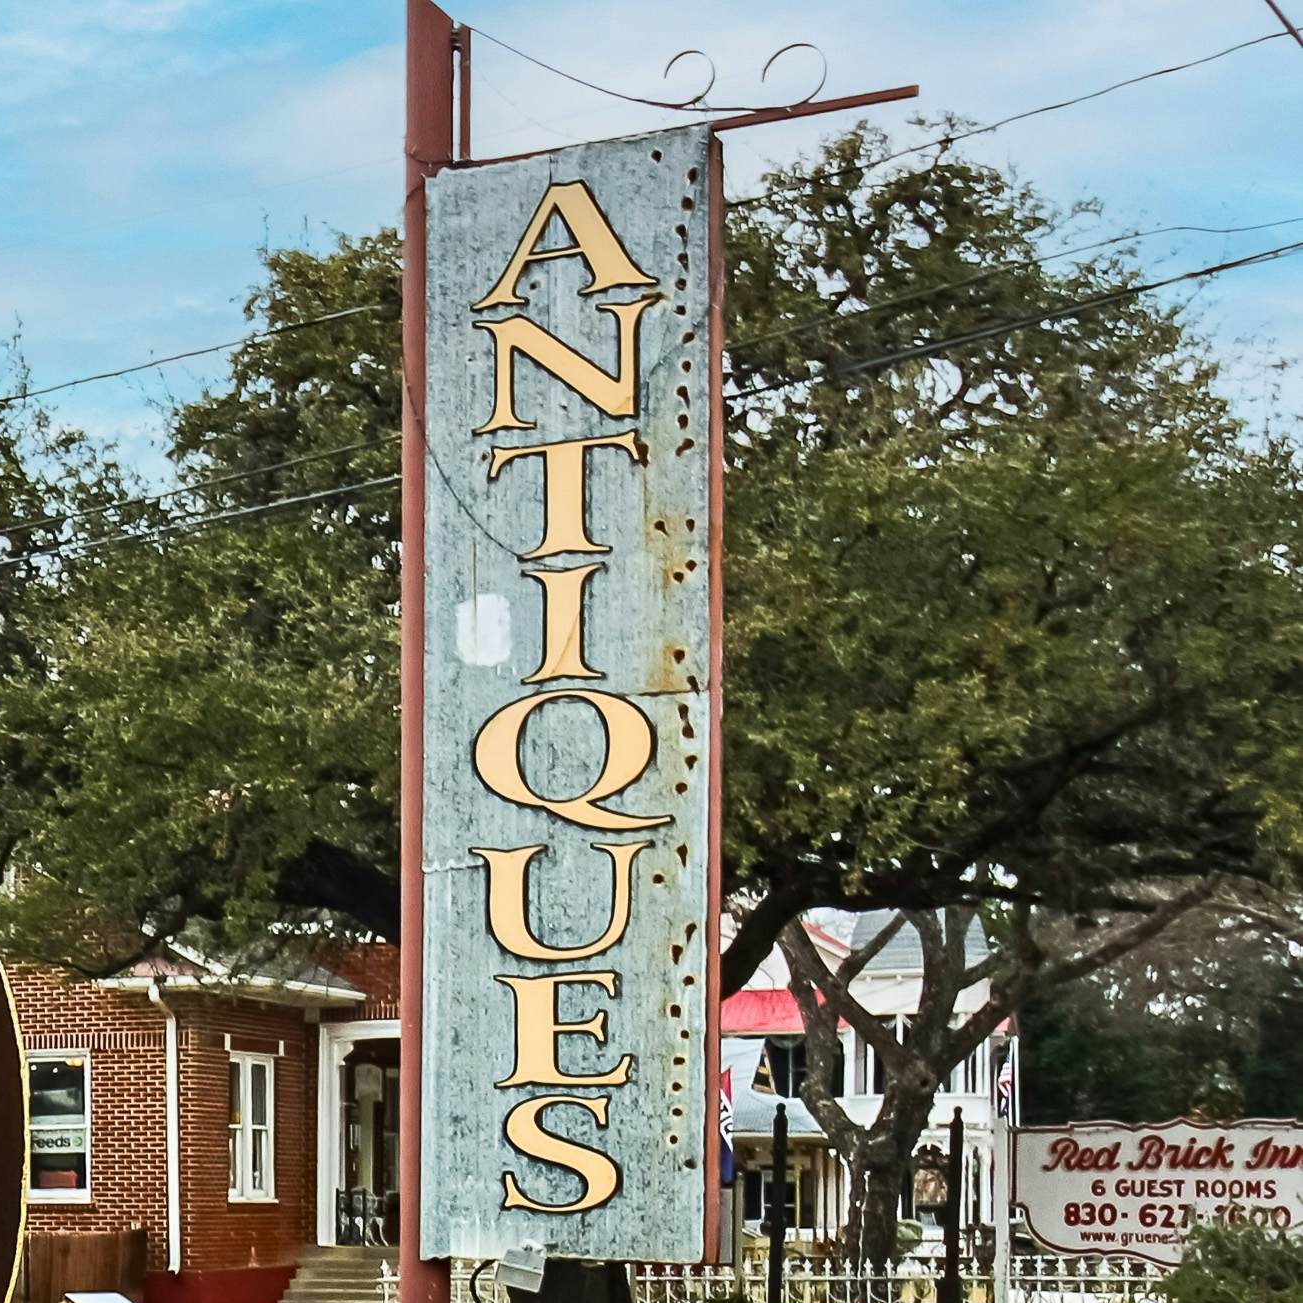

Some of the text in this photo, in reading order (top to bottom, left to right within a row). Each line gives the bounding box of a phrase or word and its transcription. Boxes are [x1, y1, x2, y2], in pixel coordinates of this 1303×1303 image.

[468, 179, 675, 1214] ANTIQUES
[1042, 1134, 1303, 1172] Red Brick Inn
[1091, 1179, 1277, 1199] 6 GUEST ROOMS
